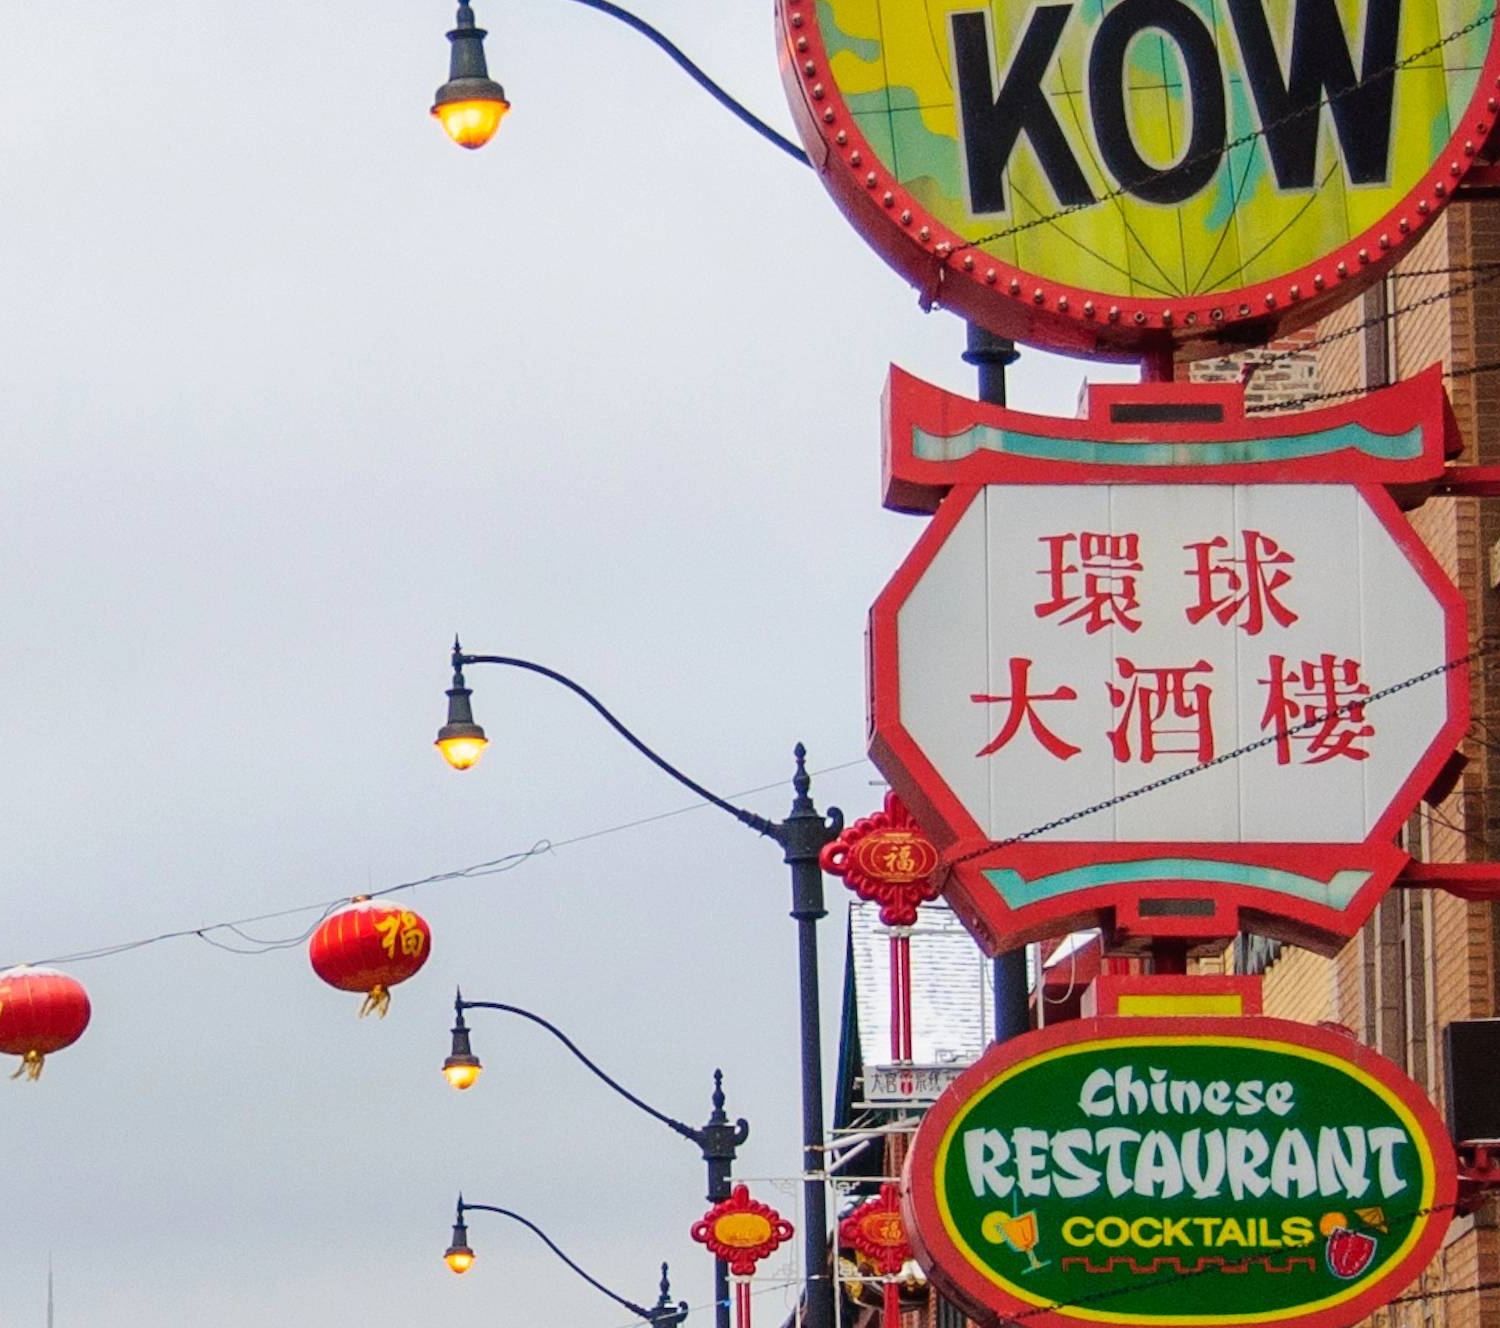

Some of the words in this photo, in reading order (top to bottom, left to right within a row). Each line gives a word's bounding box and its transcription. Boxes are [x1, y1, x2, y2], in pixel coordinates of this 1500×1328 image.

[1034, 529, 1298, 635] 環球
[970, 653, 1375, 766] 大酒樓
[1079, 1065, 1294, 1119] Chinese
[964, 1123, 1408, 1201] RESTAURANT
[1061, 1213, 1315, 1248] COCKTAILS
